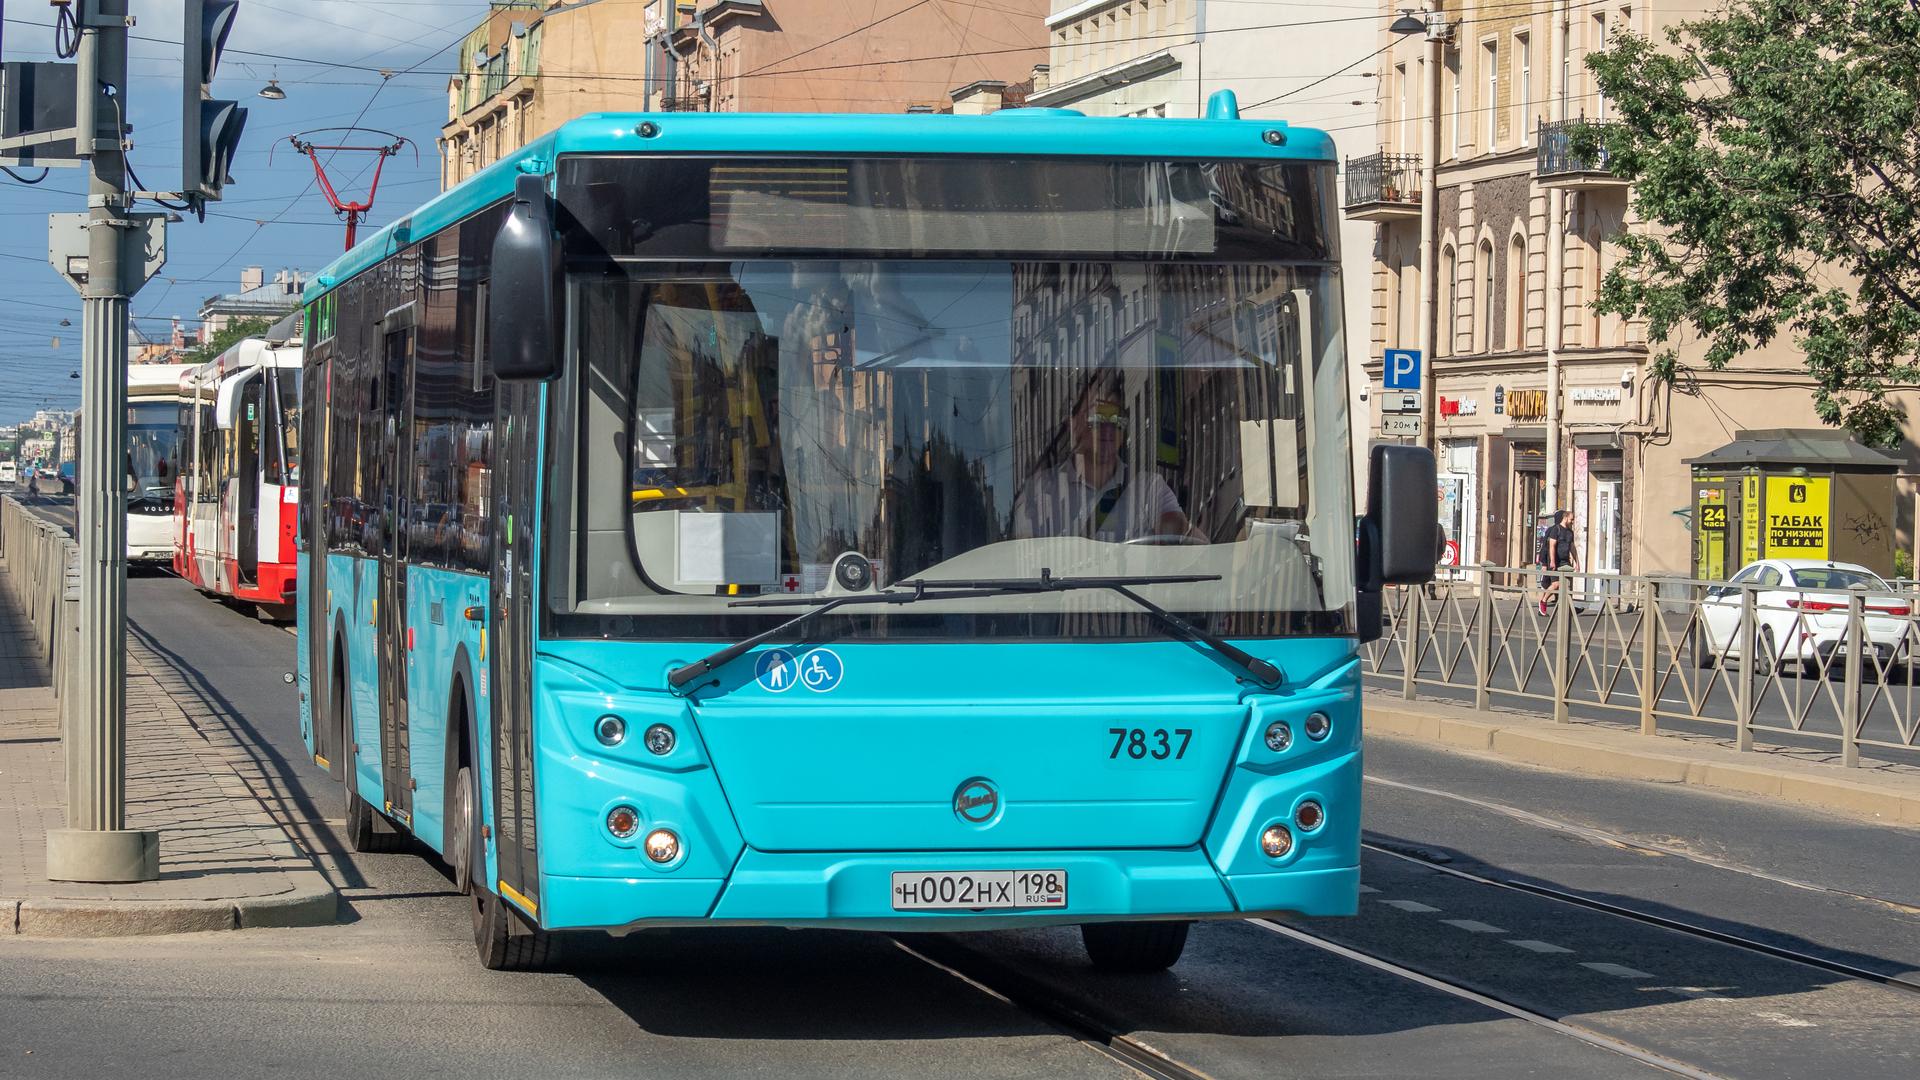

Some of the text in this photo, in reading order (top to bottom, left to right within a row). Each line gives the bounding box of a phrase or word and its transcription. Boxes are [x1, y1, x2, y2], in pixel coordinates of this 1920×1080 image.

[1704, 508, 1725, 521] 24
[1770, 515, 1823, 527] ТАБАК
[1770, 529, 1823, 538] ПО НИЗКИМ
[1770, 538, 1823, 547] ЦЕНАМ
[1109, 727, 1193, 760] 7837
[1017, 873, 1058, 895] 198
[1026, 894, 1046, 903] RUS
